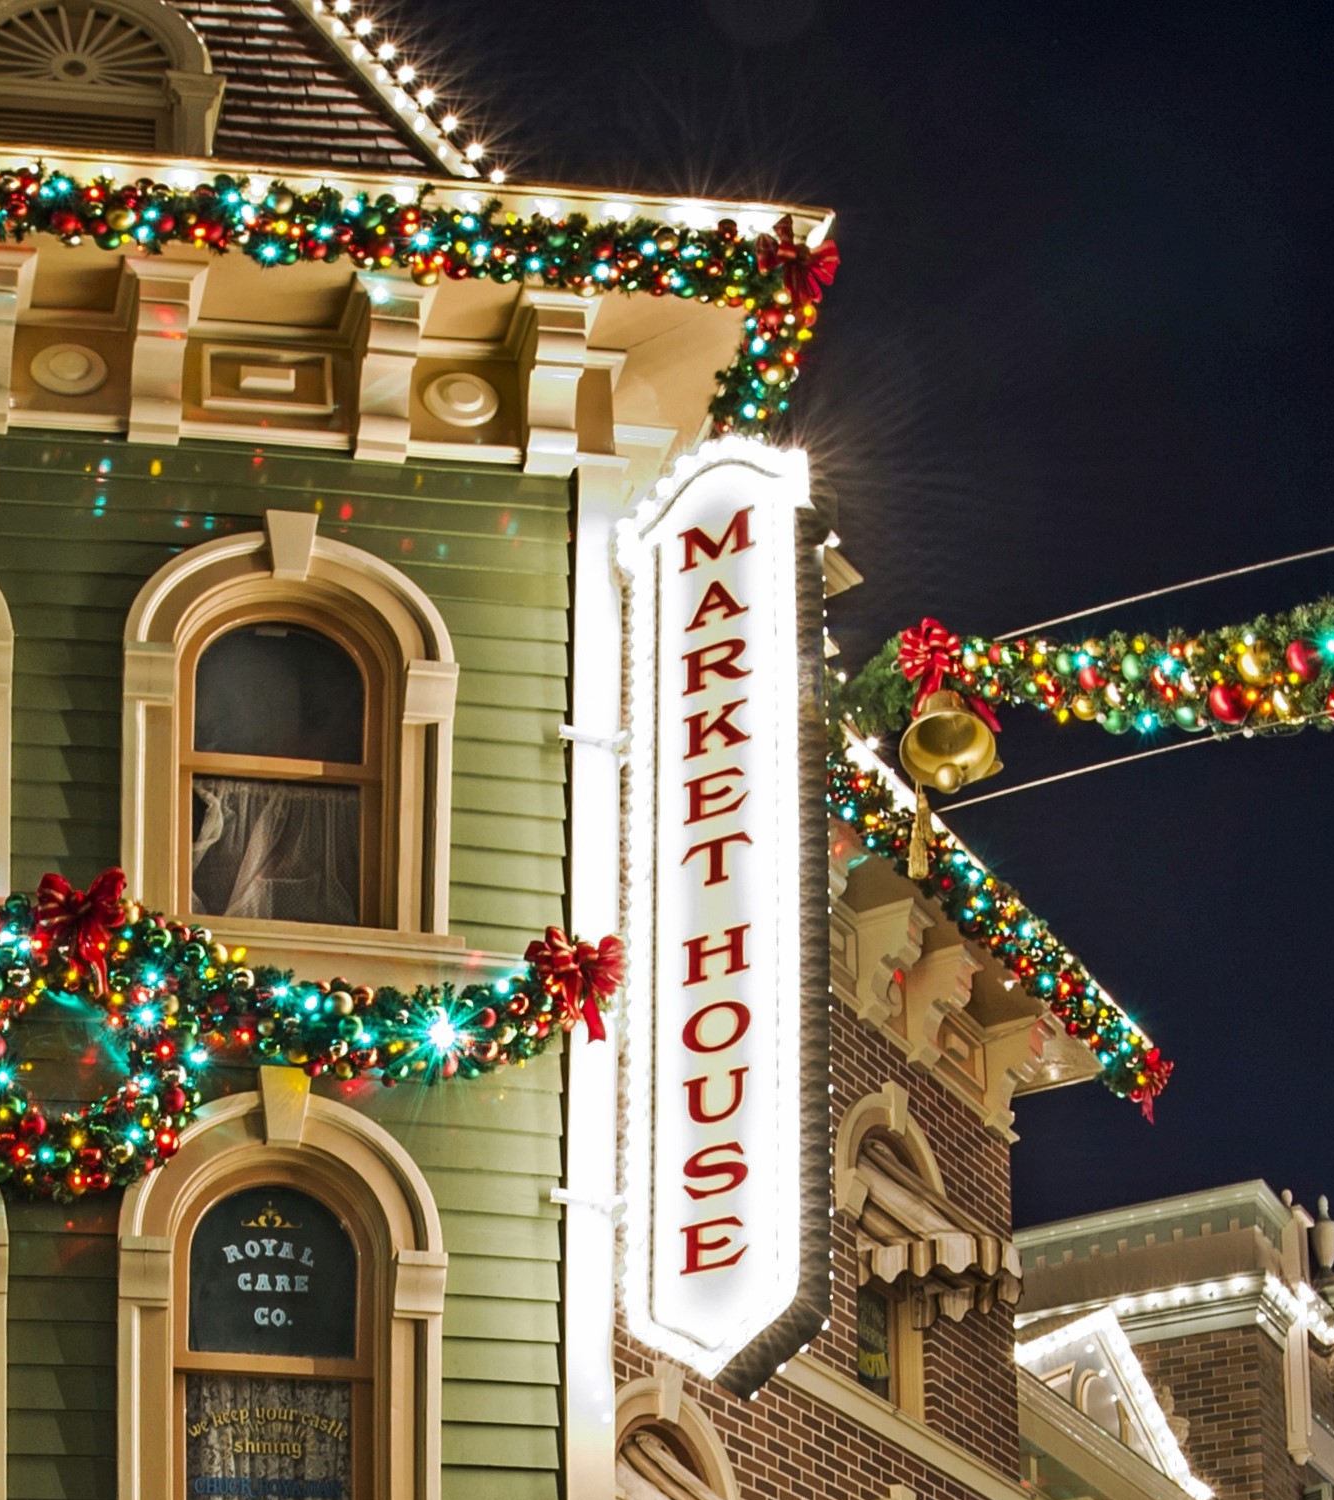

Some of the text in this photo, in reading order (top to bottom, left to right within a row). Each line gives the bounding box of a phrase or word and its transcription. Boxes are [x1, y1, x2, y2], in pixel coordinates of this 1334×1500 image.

[677, 504, 757, 1277] MARKET HOUSE
[223, 1238, 315, 1268] ROYAL
[238, 1272, 309, 1293] CARE
[254, 1307, 293, 1327] CO.
[188, 1407, 348, 1442] we keep your castle
[234, 1437, 302, 1460] shining
[194, 1476, 257, 1499] CHUCK
